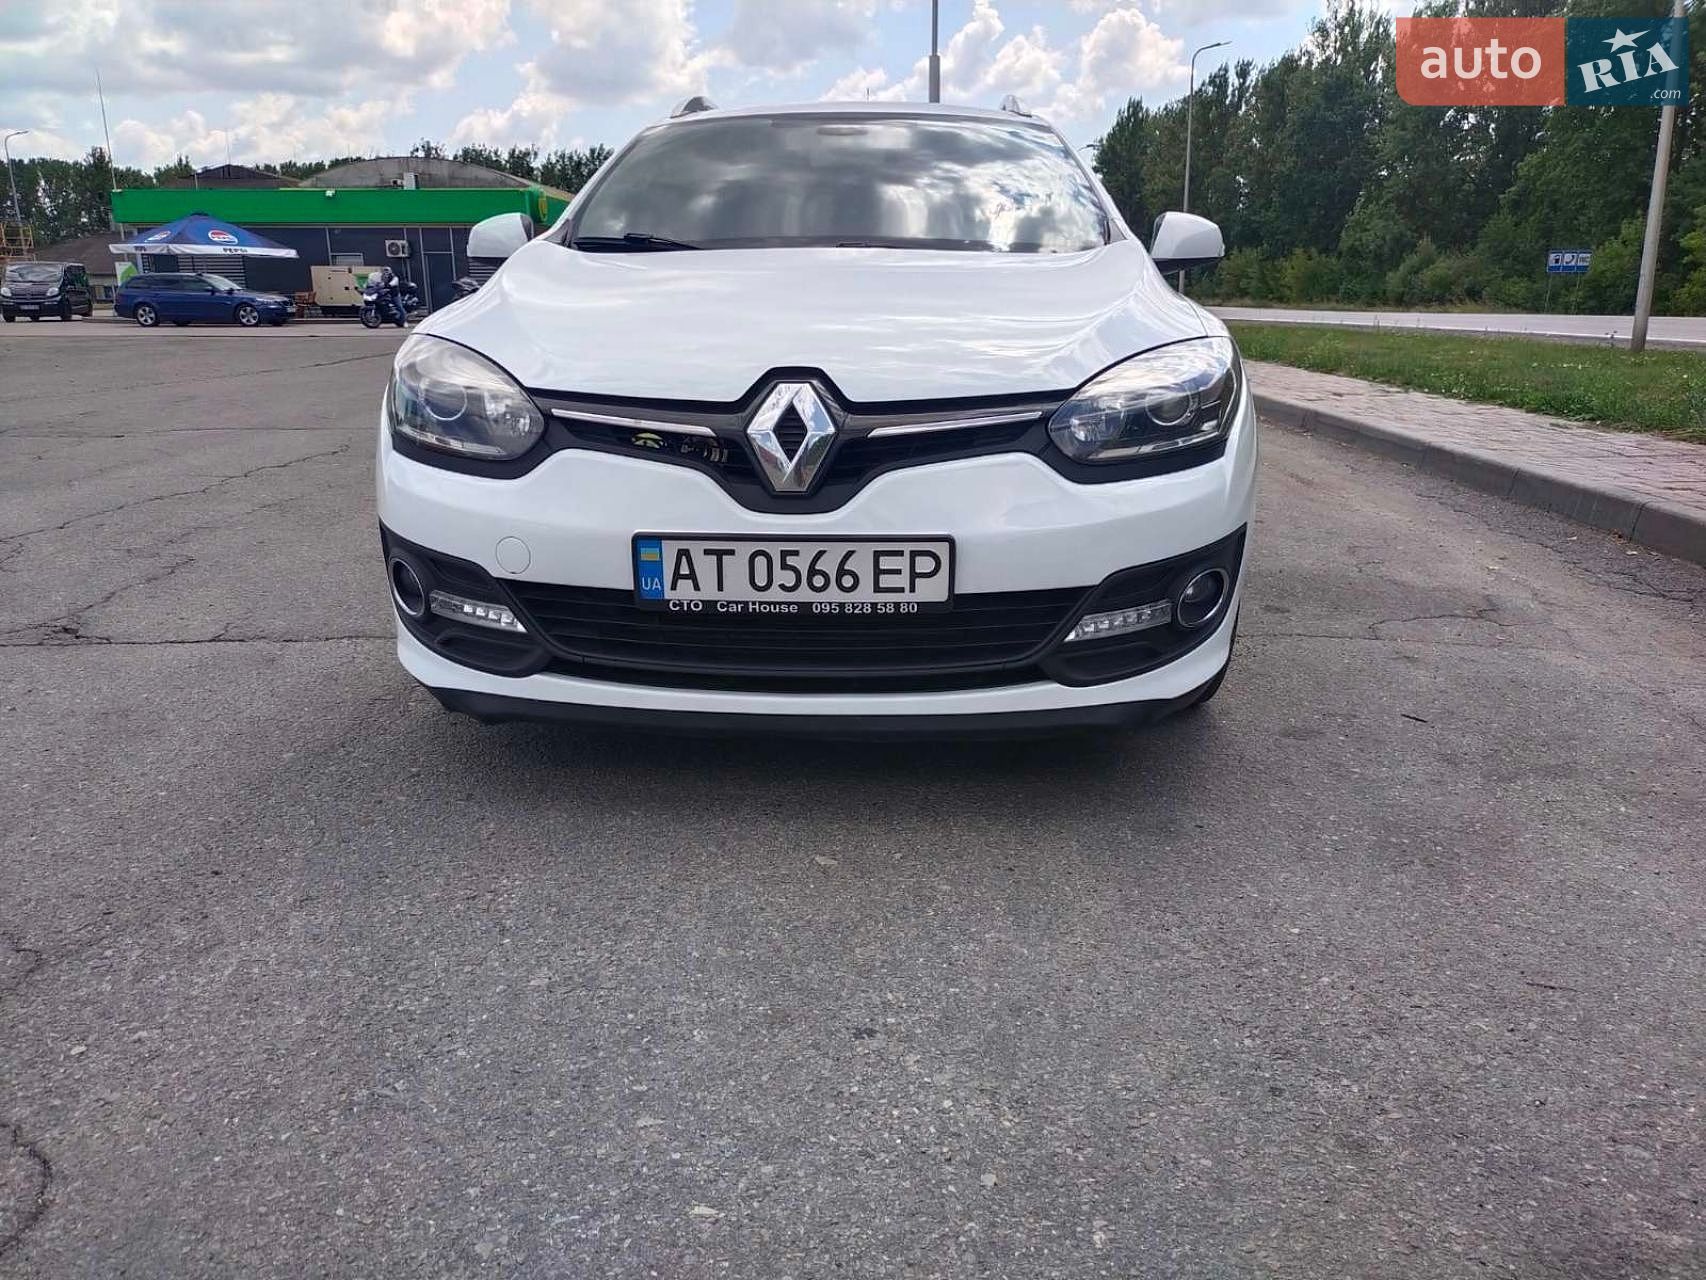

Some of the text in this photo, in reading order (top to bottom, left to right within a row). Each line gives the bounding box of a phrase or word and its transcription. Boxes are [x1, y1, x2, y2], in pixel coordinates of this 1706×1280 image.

[670, 548, 942, 593] AT 0566 EP
[642, 577, 662, 590] UA
[717, 601, 744, 612] Car
[748, 601, 799, 613] House
[812, 603, 839, 613] 095
[845, 603, 872, 613] 828
[876, 603, 895, 613] 58
[899, 603, 918, 613] 80
